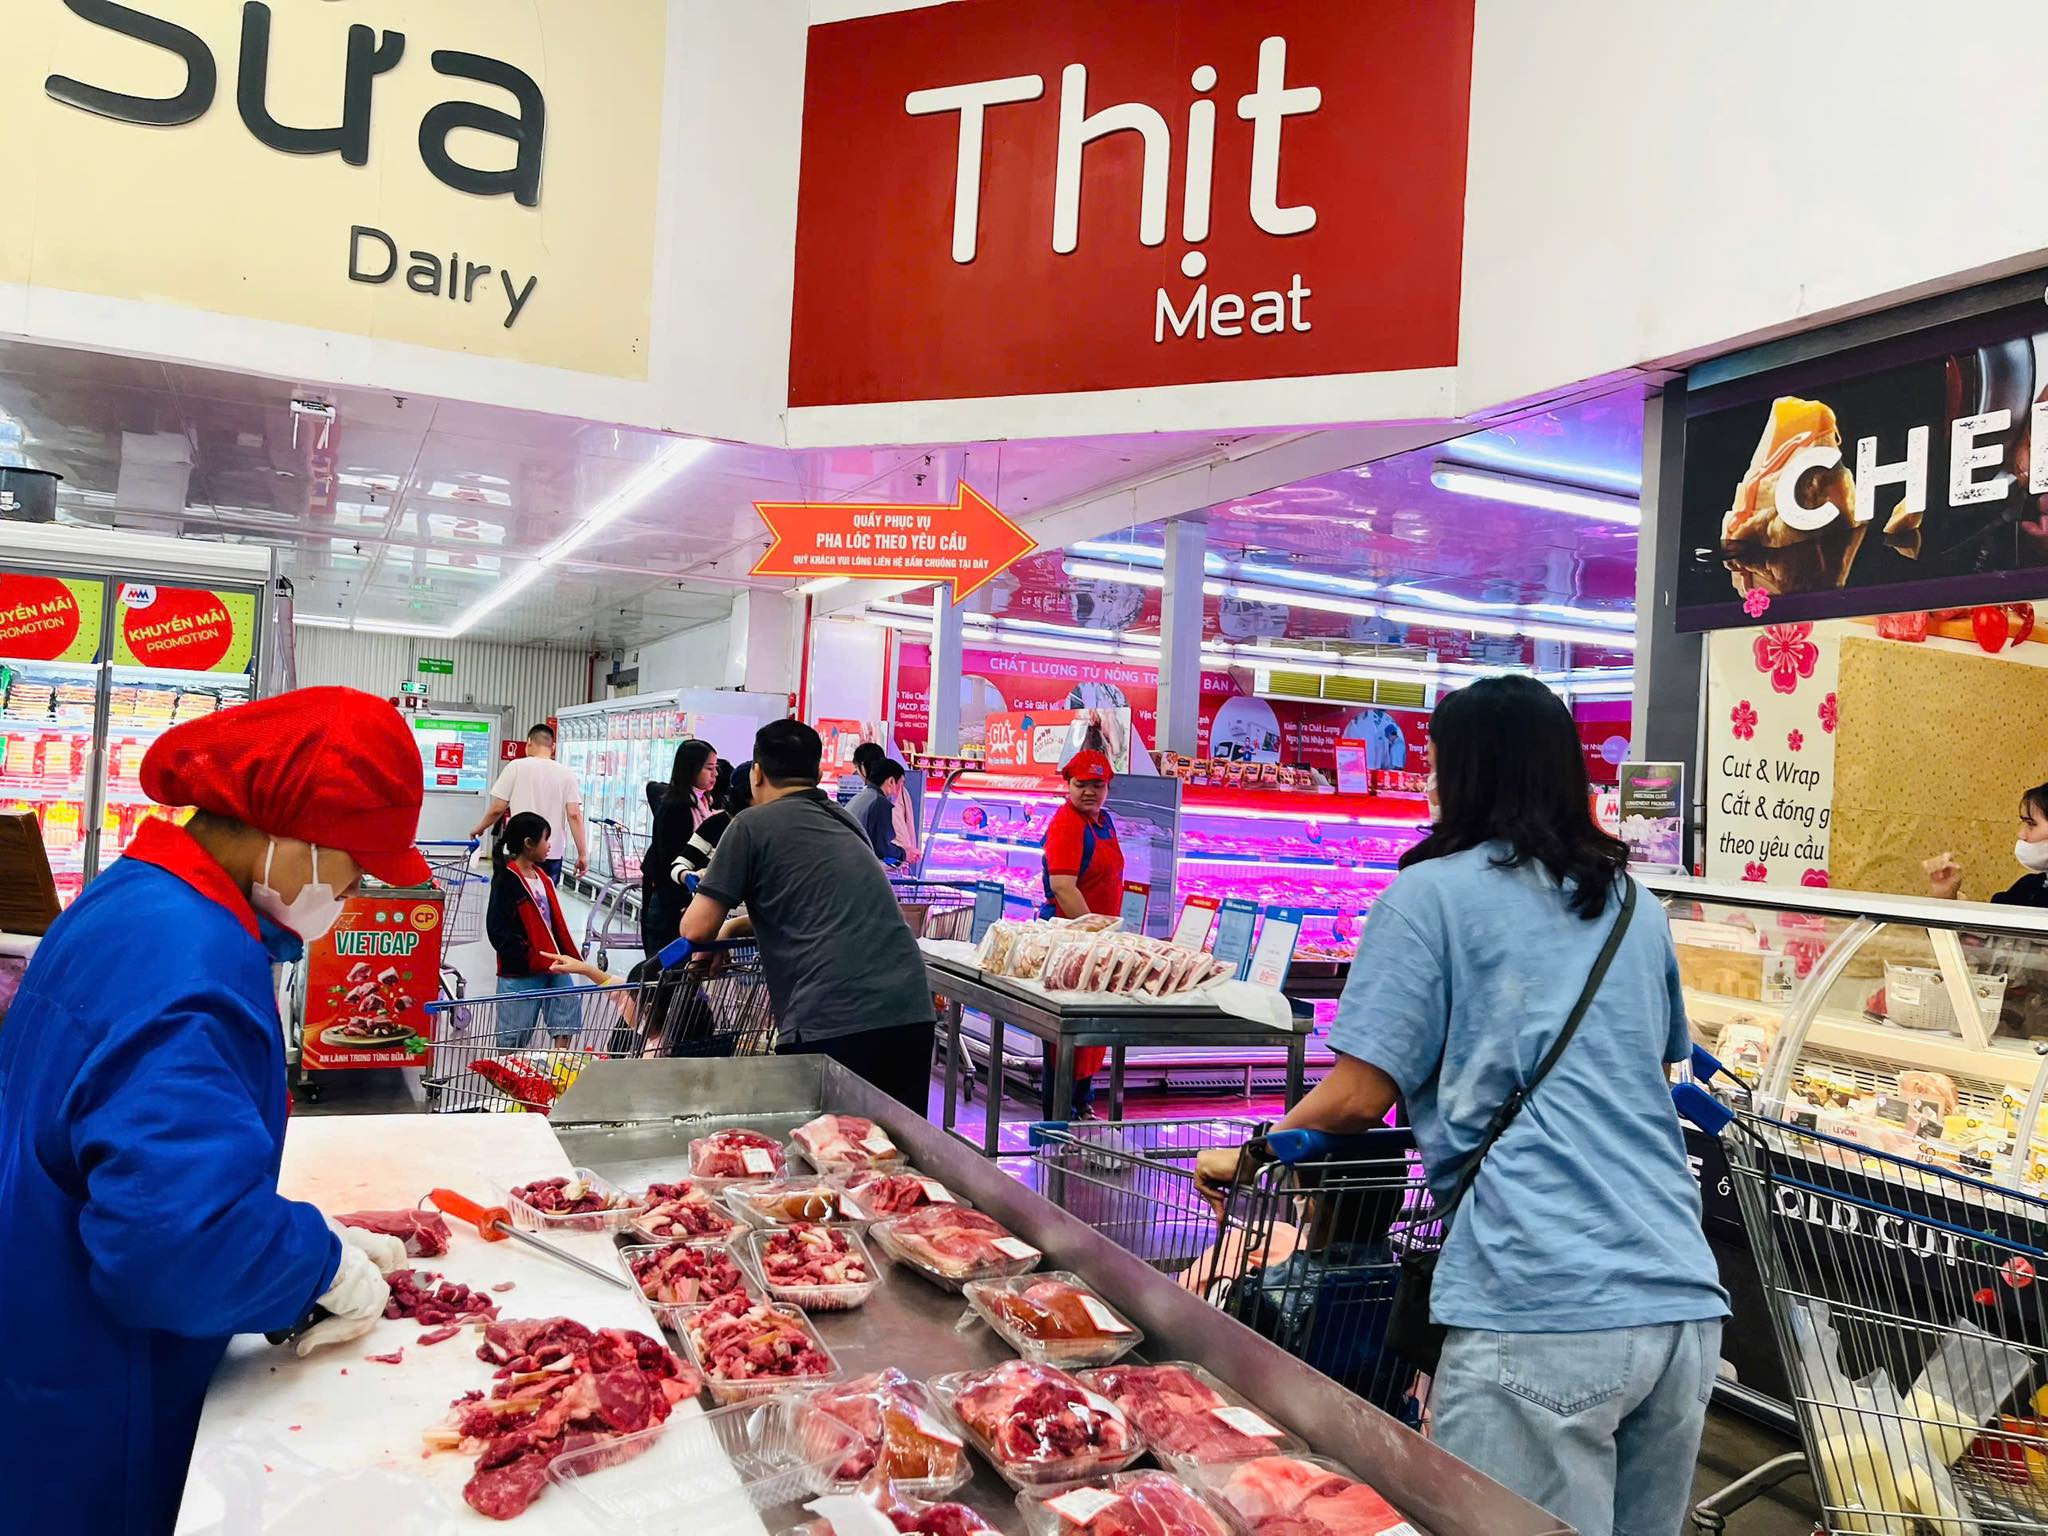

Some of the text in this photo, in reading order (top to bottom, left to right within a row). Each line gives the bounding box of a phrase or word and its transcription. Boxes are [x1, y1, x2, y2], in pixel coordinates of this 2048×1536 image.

[904, 35, 1322, 278] Thịt
[347, 224, 537, 328] Dairy
[1154, 273, 1312, 343] Meat
[884, 515, 914, 531] PHỤC
[916, 515, 931, 531] VỤ
[816, 532, 843, 549] PHA
[874, 534, 907, 550] THEO
[911, 531, 936, 551] YÊU
[41, 596, 72, 615] MÃI
[128, 608, 226, 642] KHUYẾN MÃI
[146, 628, 219, 653] PROMOTION
[990, 654, 1028, 673] CHẤT
[1031, 661, 1078, 678] LƯỢNG
[1104, 667, 1138, 683] NÔNG
[1722, 755, 1820, 791] Cut & Wrap
[1721, 790, 1751, 816] Cắt
[1755, 796, 1768, 820] &
[1772, 798, 1815, 828] đóng
[1719, 832, 1825, 862] theo yêu cầu
[414, 912, 434, 923] CP
[336, 931, 419, 955] VIETGAP
[350, 1053, 371, 1062] TRONG
[1760, 1178, 1966, 1266] OLD CUT
